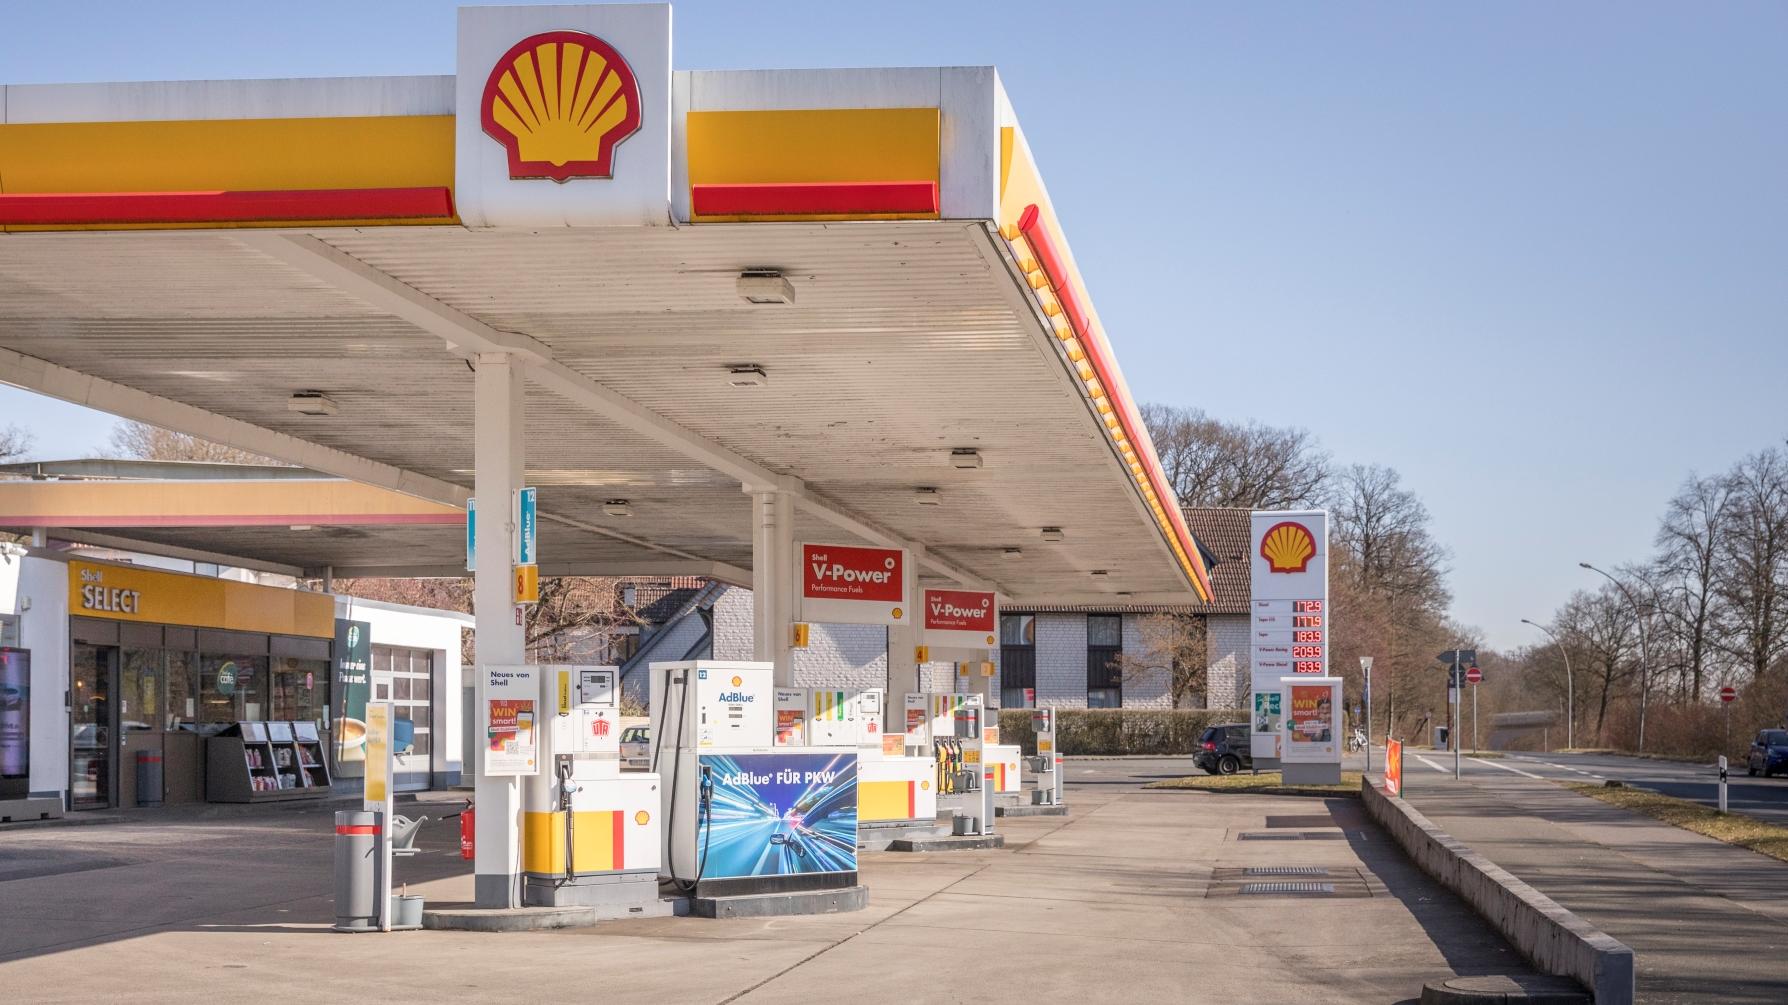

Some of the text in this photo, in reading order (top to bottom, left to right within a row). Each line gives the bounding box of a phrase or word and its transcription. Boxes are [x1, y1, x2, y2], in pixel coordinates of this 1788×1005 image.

[528, 490, 535, 503] 12
[81, 569, 103, 582] Shell
[812, 563, 892, 584] V-Power
[518, 575, 523, 595] 8
[811, 584, 848, 593] Performance
[84, 585, 141, 613] SELECT
[931, 603, 987, 618] V-Power
[1294, 700, 1318, 708] WIN
[493, 708, 516, 717] WIN
[776, 769, 801, 785] FÜR
[805, 771, 836, 784] PKW
